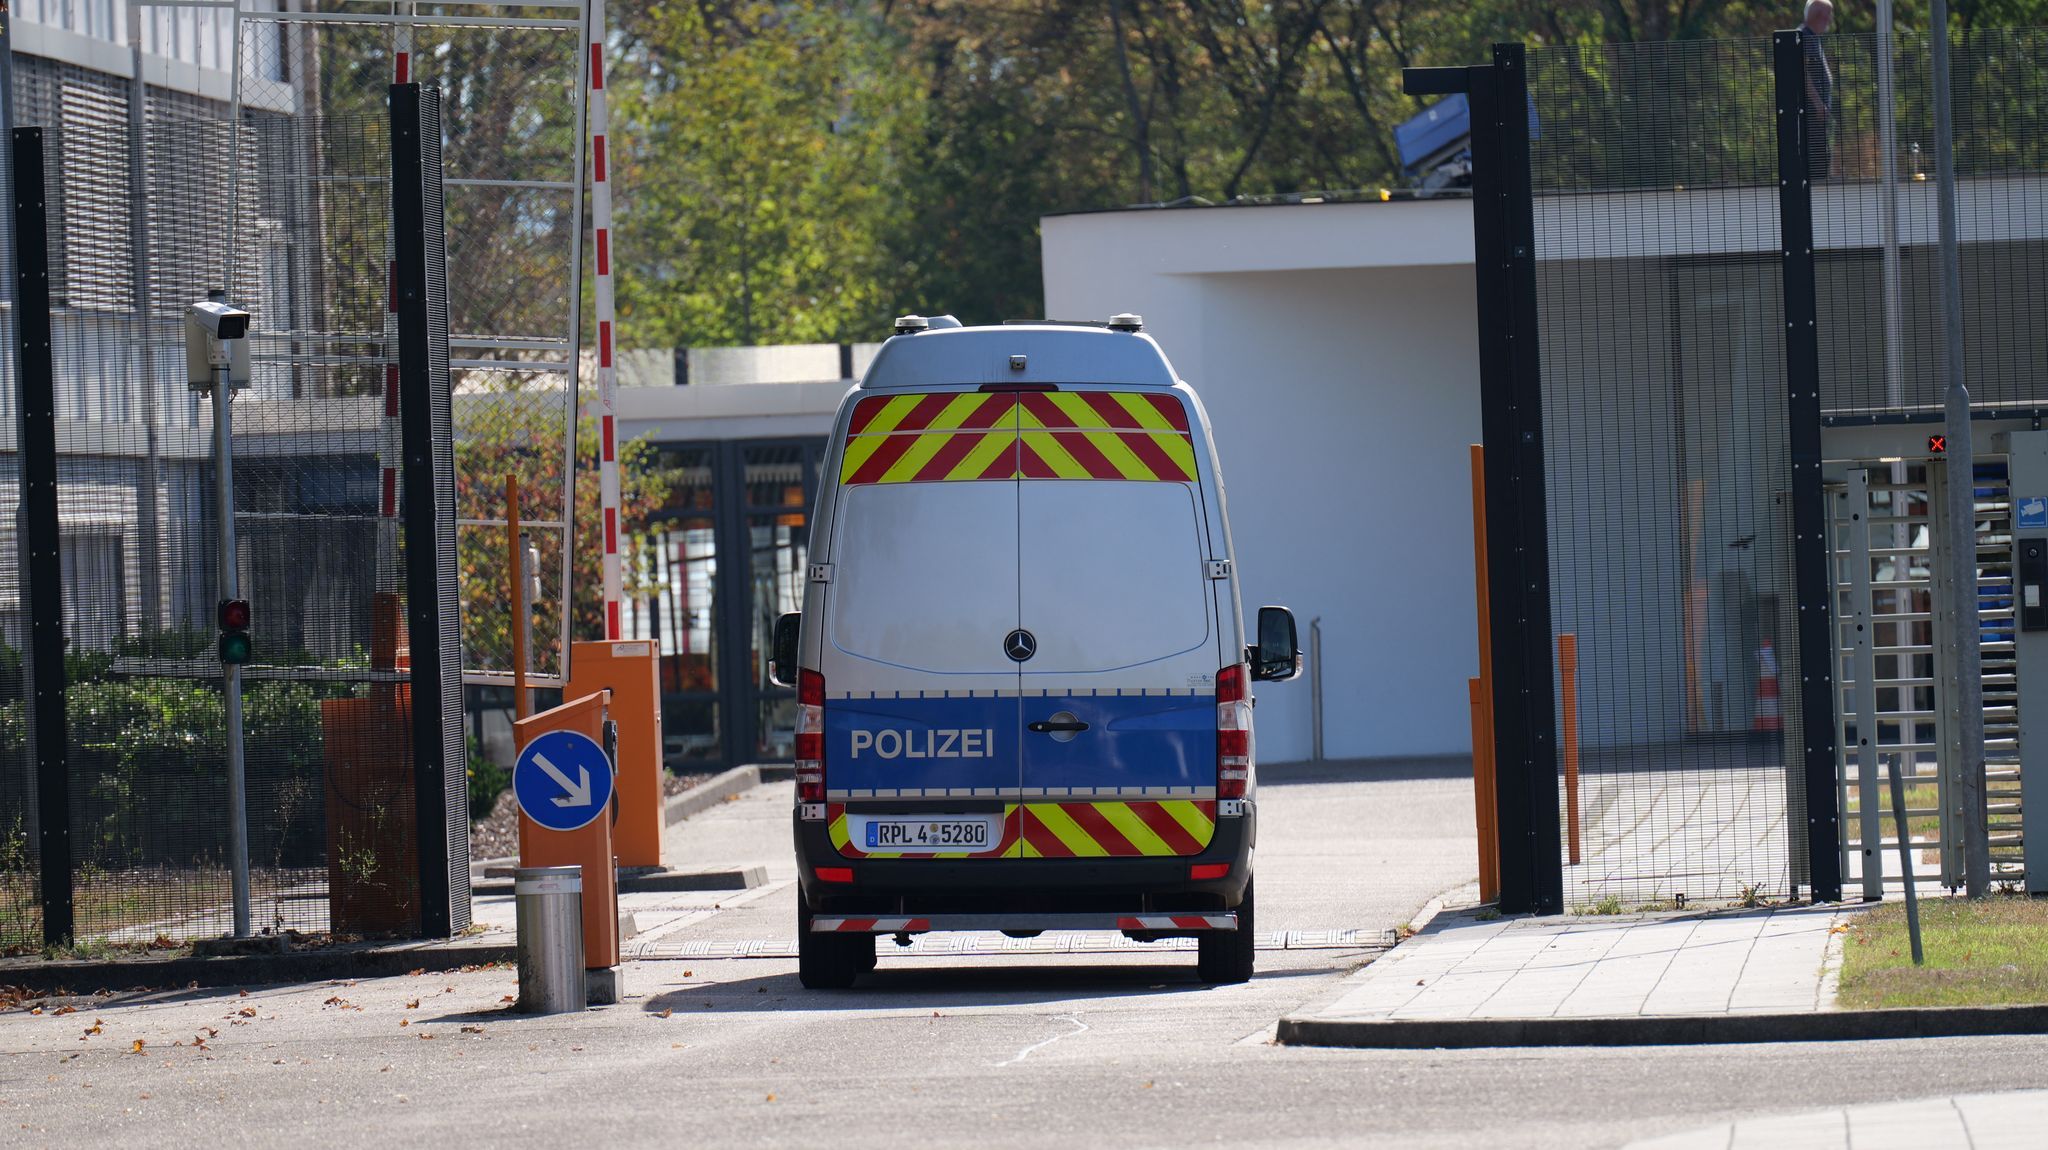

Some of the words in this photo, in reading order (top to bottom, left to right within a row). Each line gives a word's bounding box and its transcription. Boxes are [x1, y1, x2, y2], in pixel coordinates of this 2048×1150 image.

[851, 728, 994, 759] POLIZEI
[879, 825, 913, 844] RPL
[917, 825, 928, 844] 4
[941, 824, 985, 844] 5280
